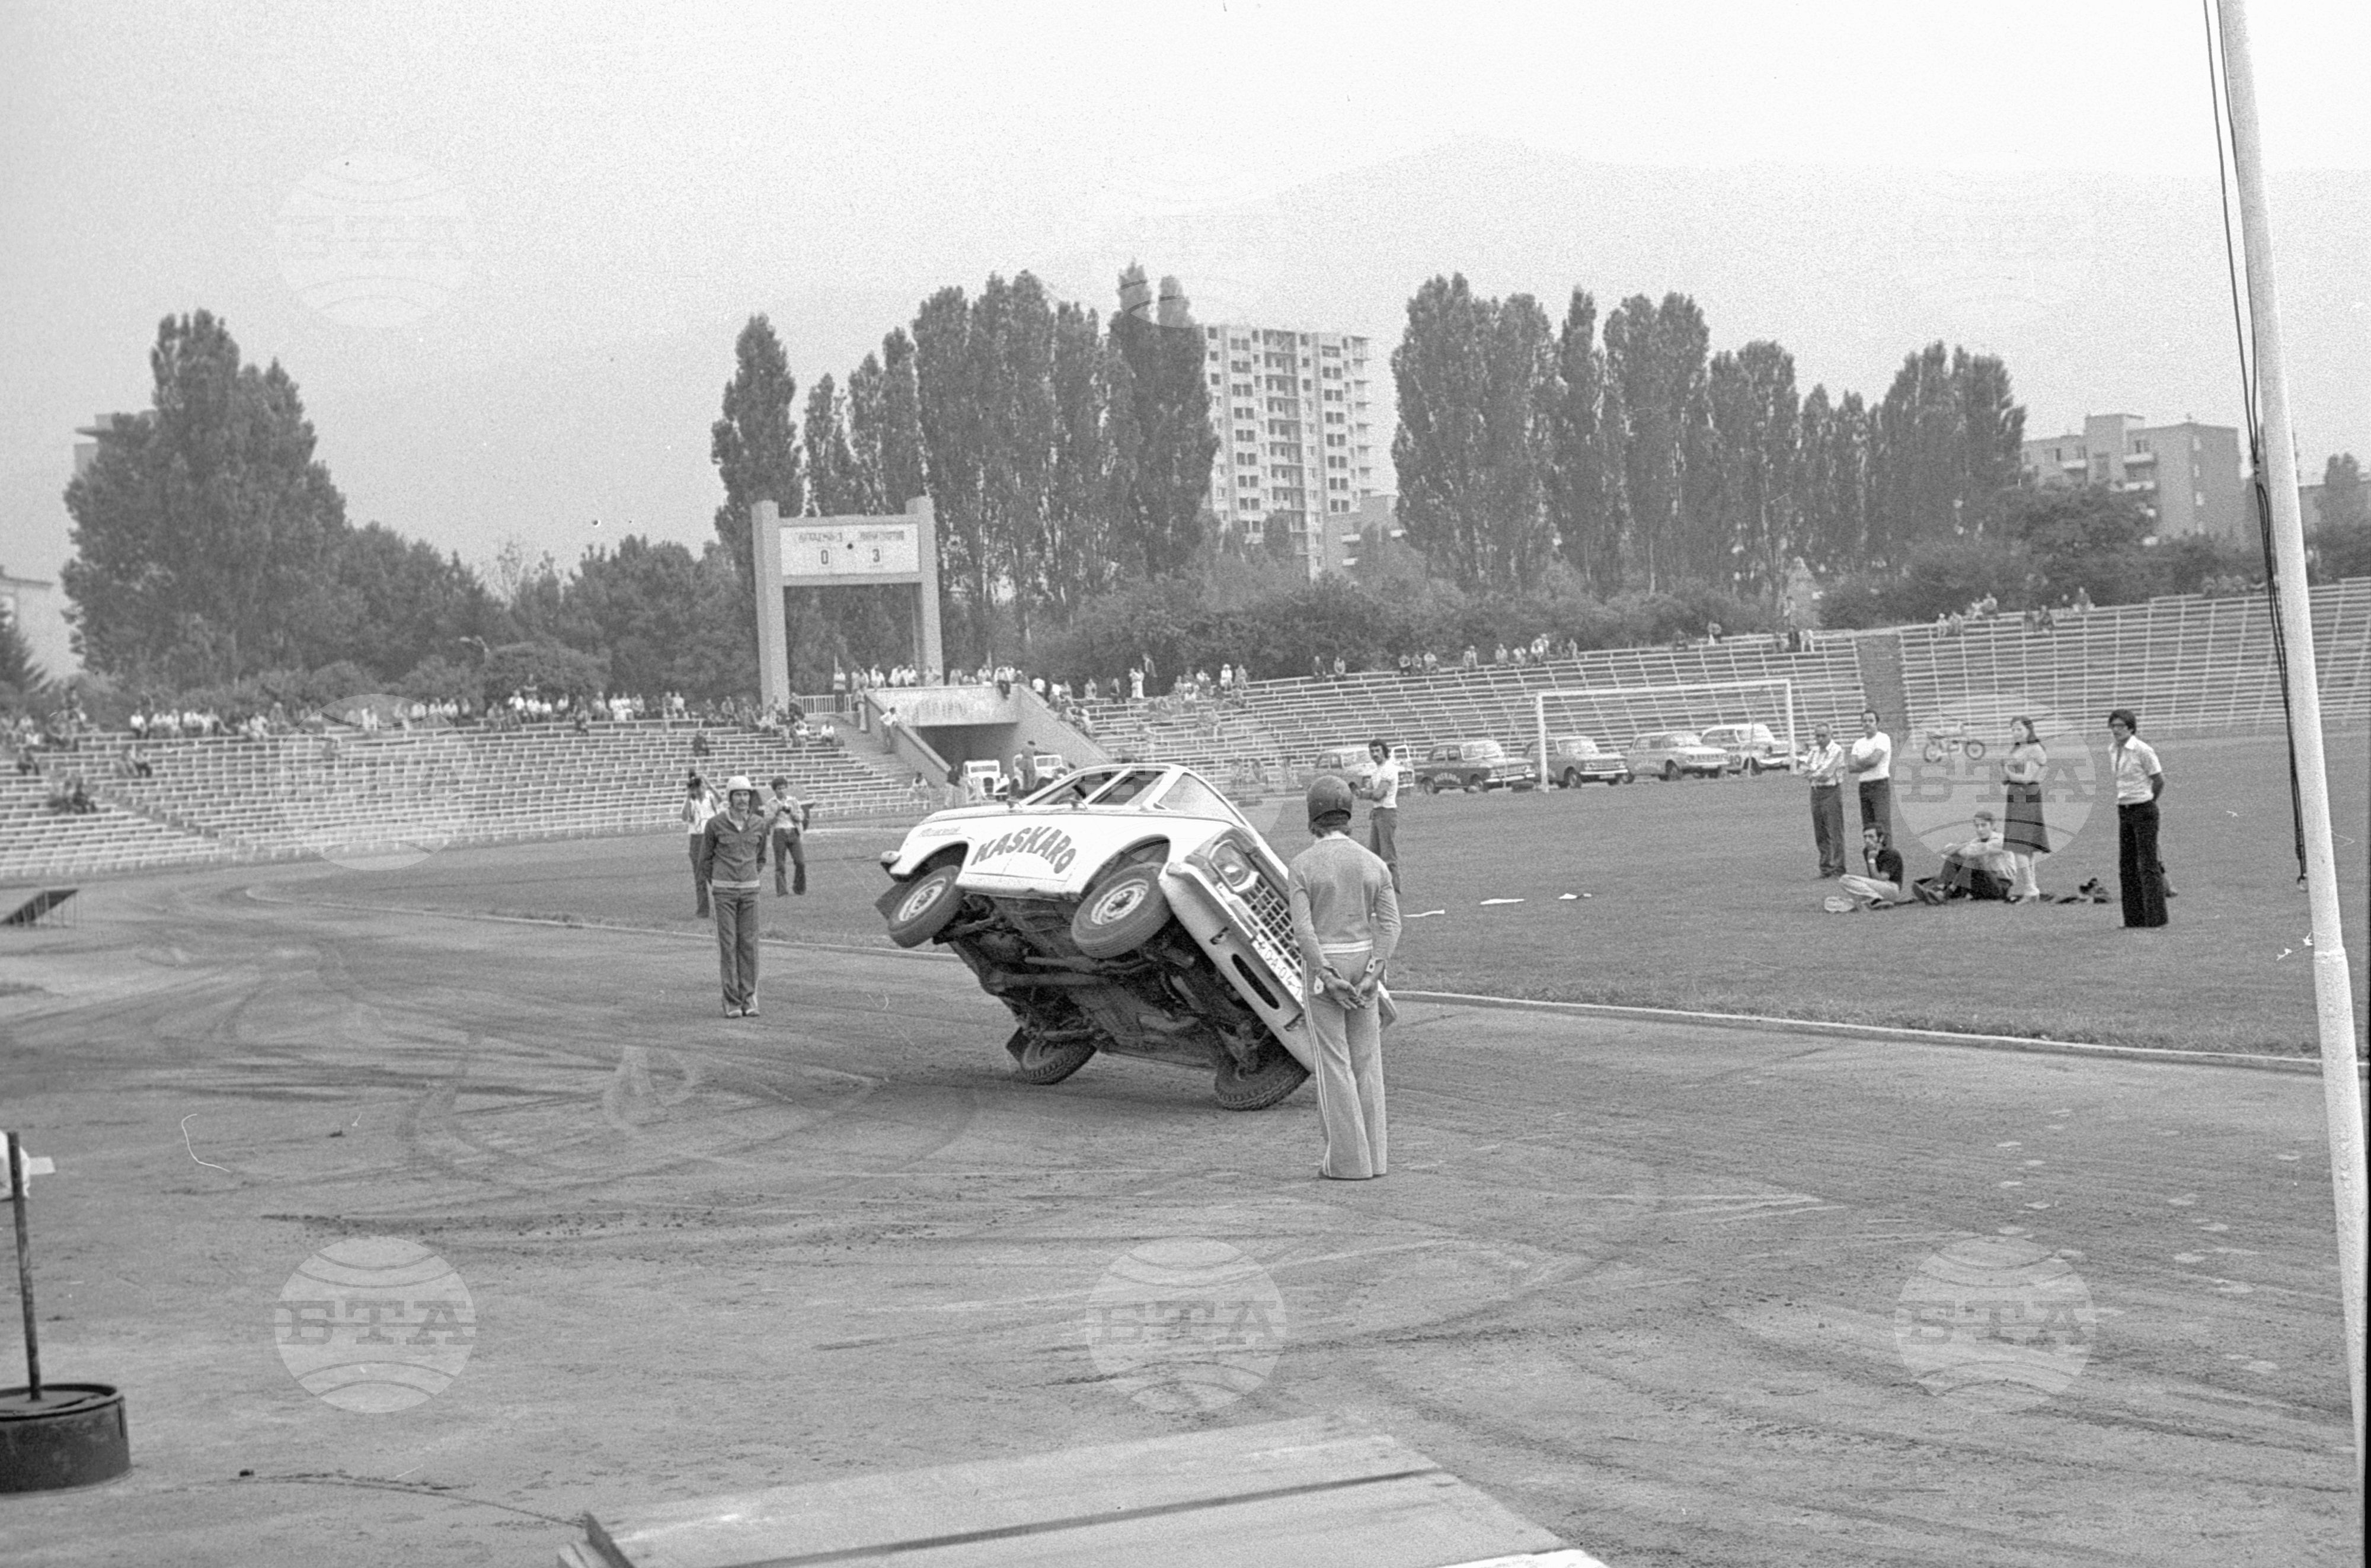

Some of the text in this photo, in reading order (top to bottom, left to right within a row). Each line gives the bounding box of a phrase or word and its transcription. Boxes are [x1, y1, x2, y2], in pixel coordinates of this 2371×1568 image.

[820, 548, 881, 565] 0 3
[970, 827, 1076, 874] KASKARO
